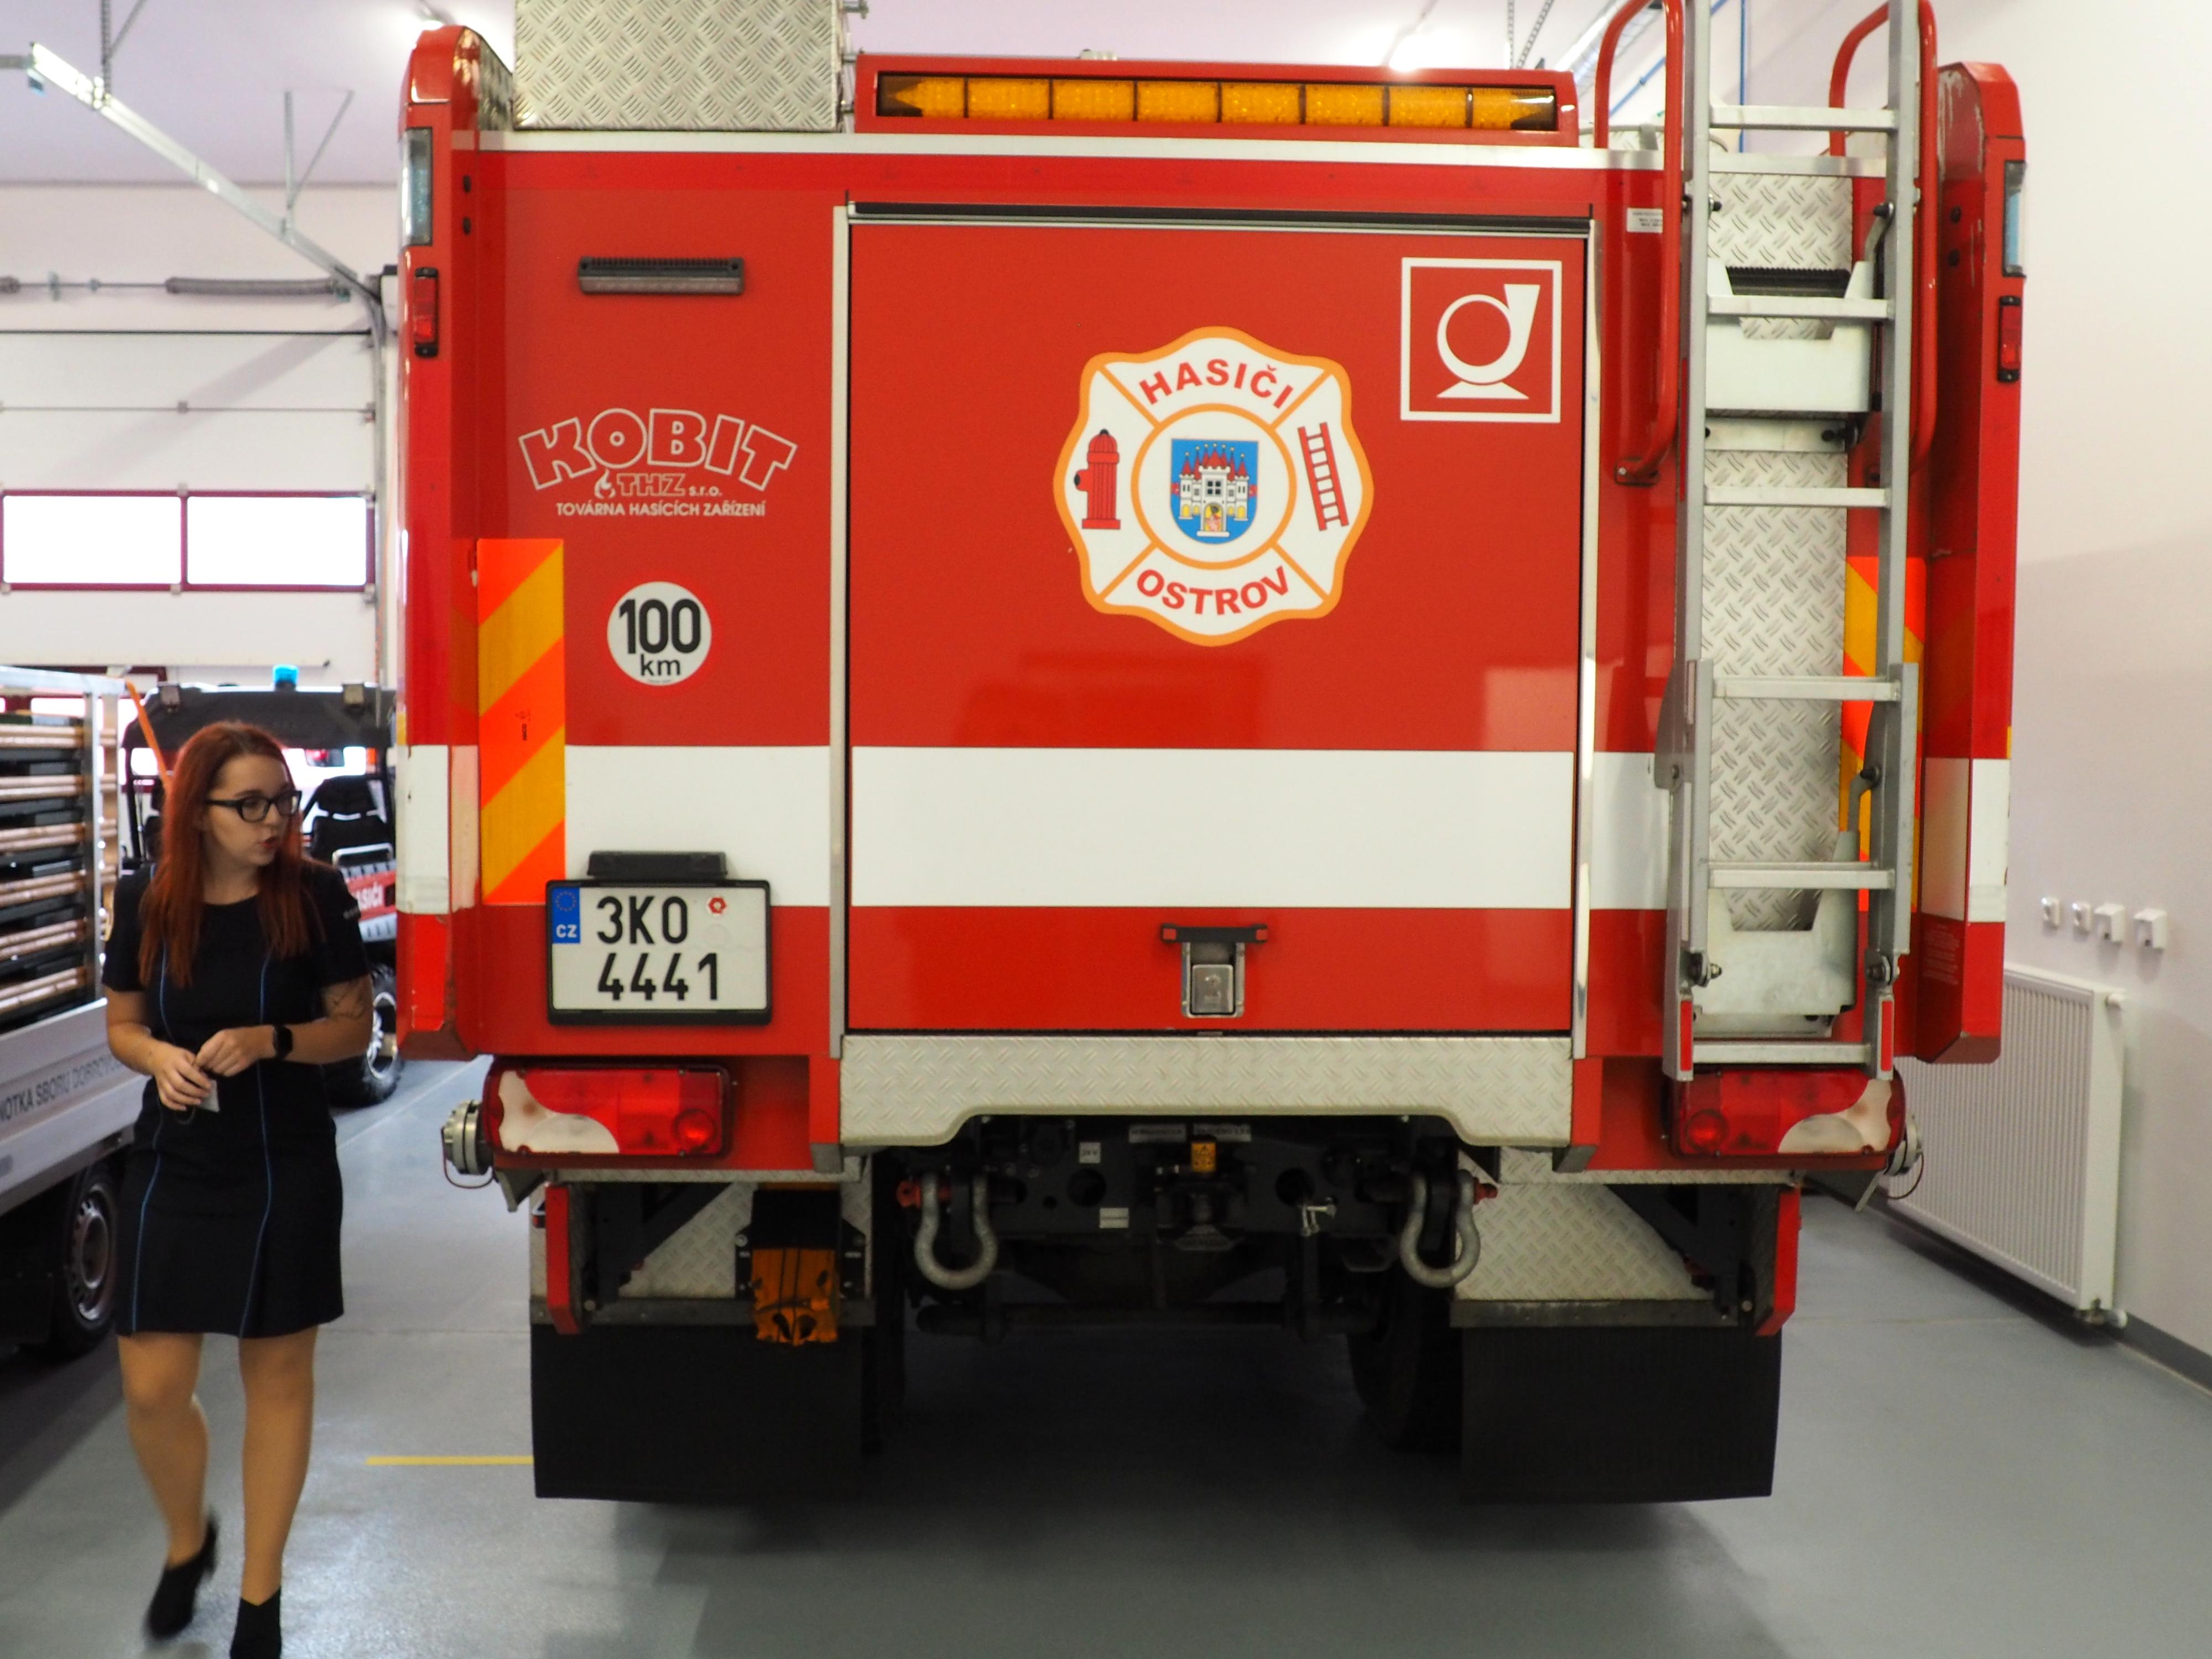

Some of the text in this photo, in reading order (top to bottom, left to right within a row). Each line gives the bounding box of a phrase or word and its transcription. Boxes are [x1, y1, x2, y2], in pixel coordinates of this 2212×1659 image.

[1139, 358, 1293, 409] HASIČI
[518, 408, 798, 491] KOBIT
[557, 499, 766, 516] TOVÁRNA HASÍCÍCH ZAŘÍZENÍ
[617, 473, 722, 497] THZ s.r.o.
[1137, 566, 1288, 615] OSTROV
[619, 598, 701, 655] 100
[640, 655, 681, 676] km
[556, 924, 577, 938] CZ
[598, 953, 718, 1001] 4441
